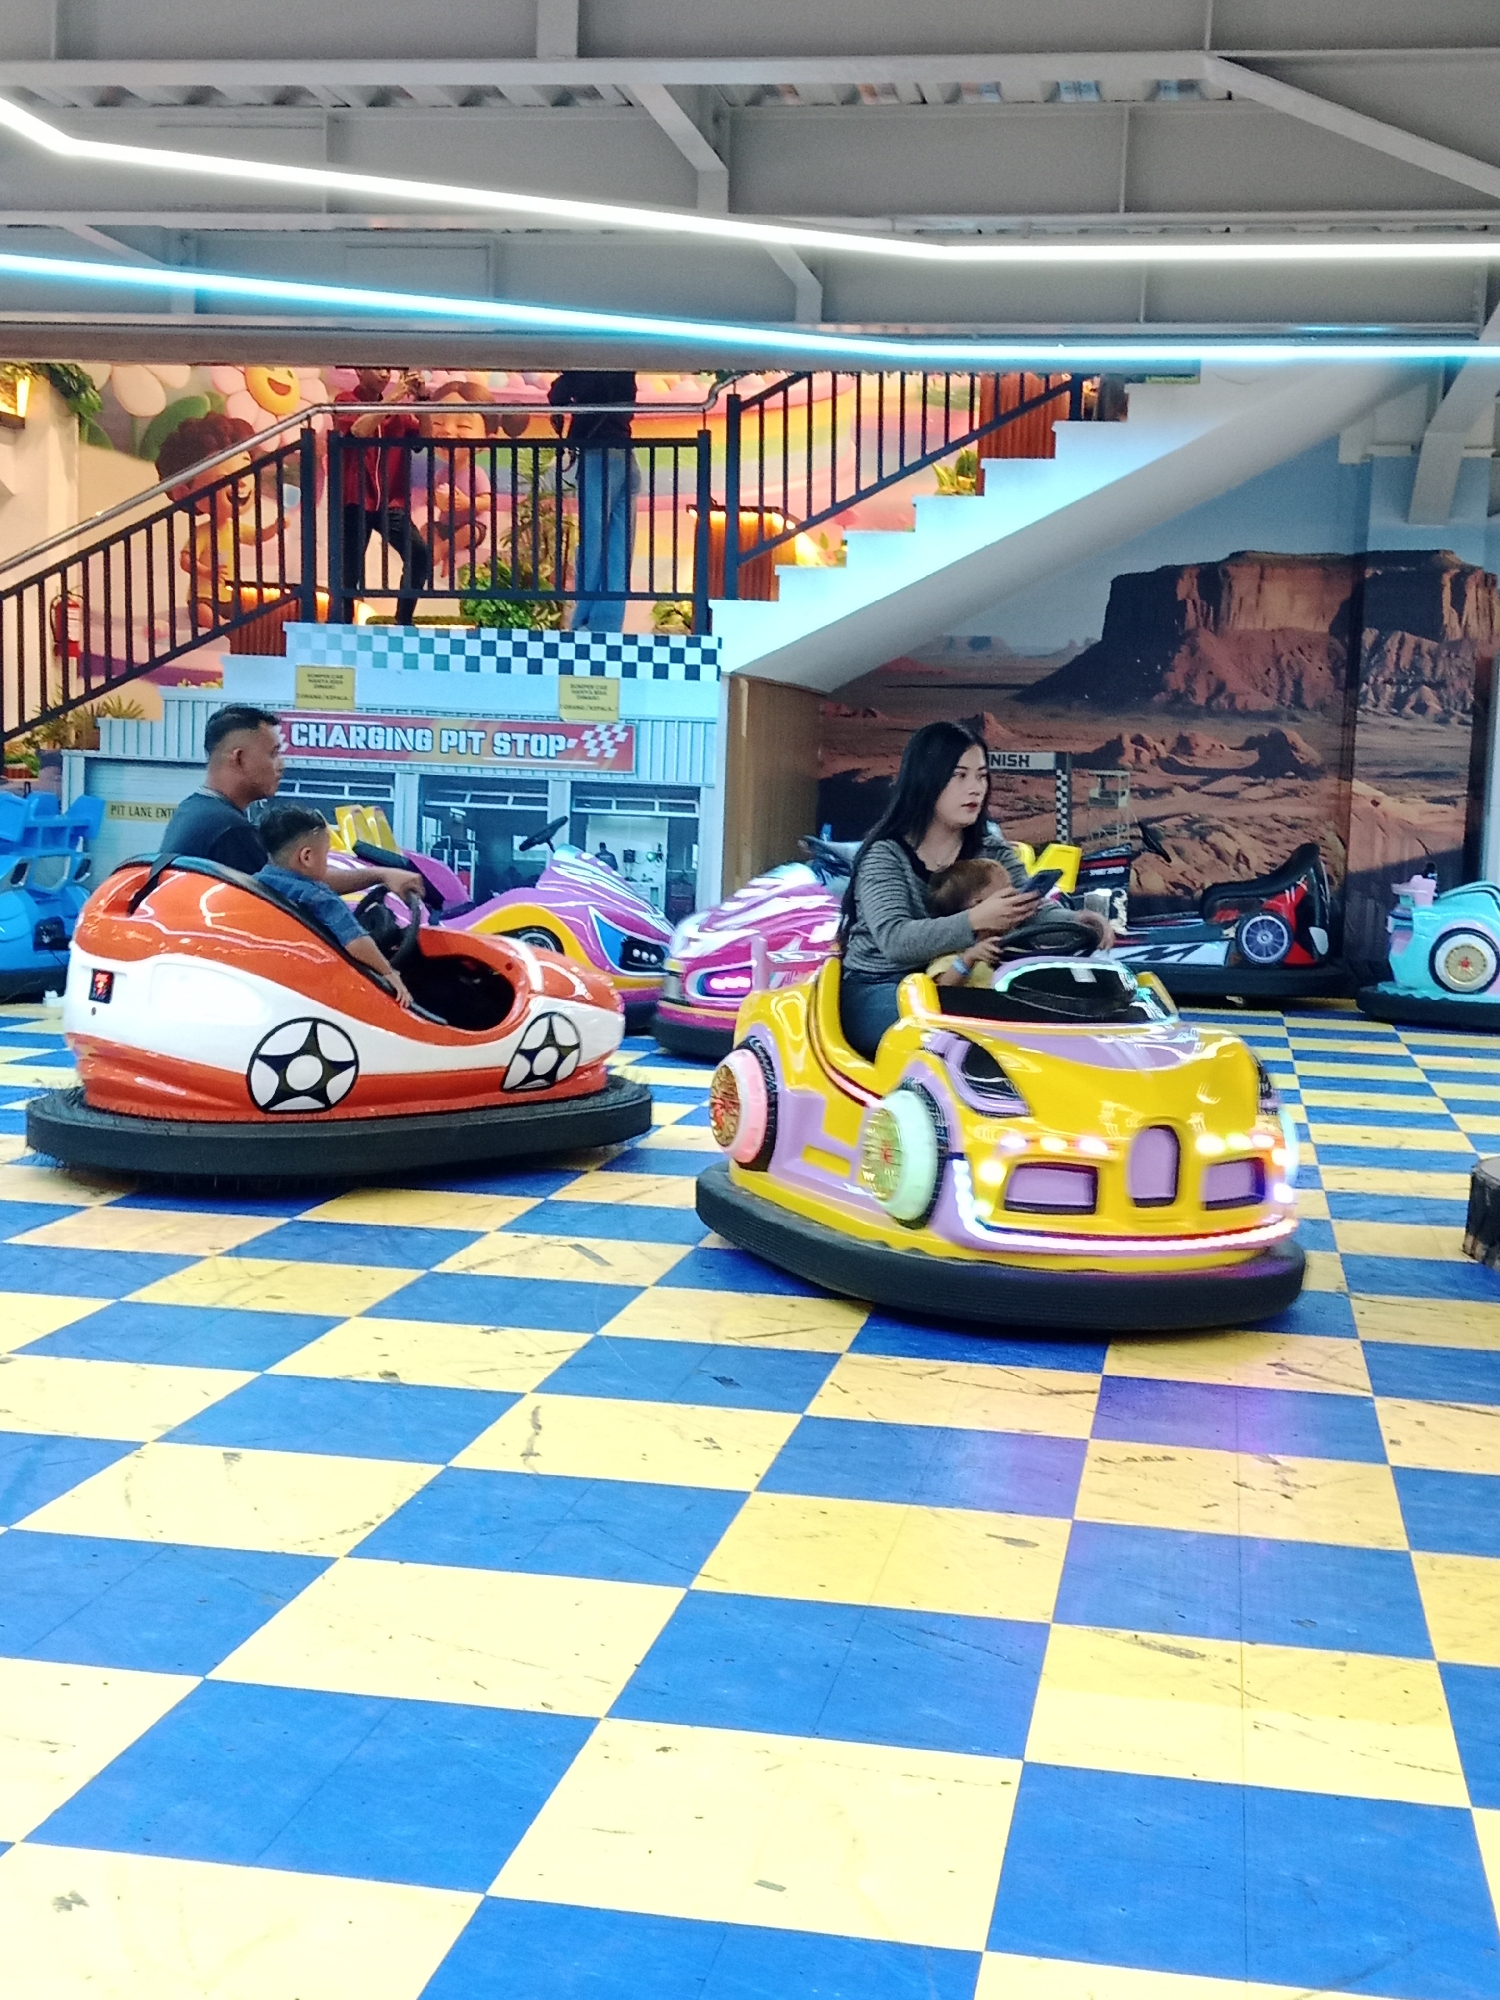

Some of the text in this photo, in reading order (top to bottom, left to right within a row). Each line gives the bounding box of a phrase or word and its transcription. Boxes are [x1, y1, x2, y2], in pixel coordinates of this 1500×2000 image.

[290, 722, 567, 759] CHARGING PIT STOP
[988, 753, 1030, 767] NISH
[111, 804, 125, 816] PIT
[129, 806, 152, 818] LANE
